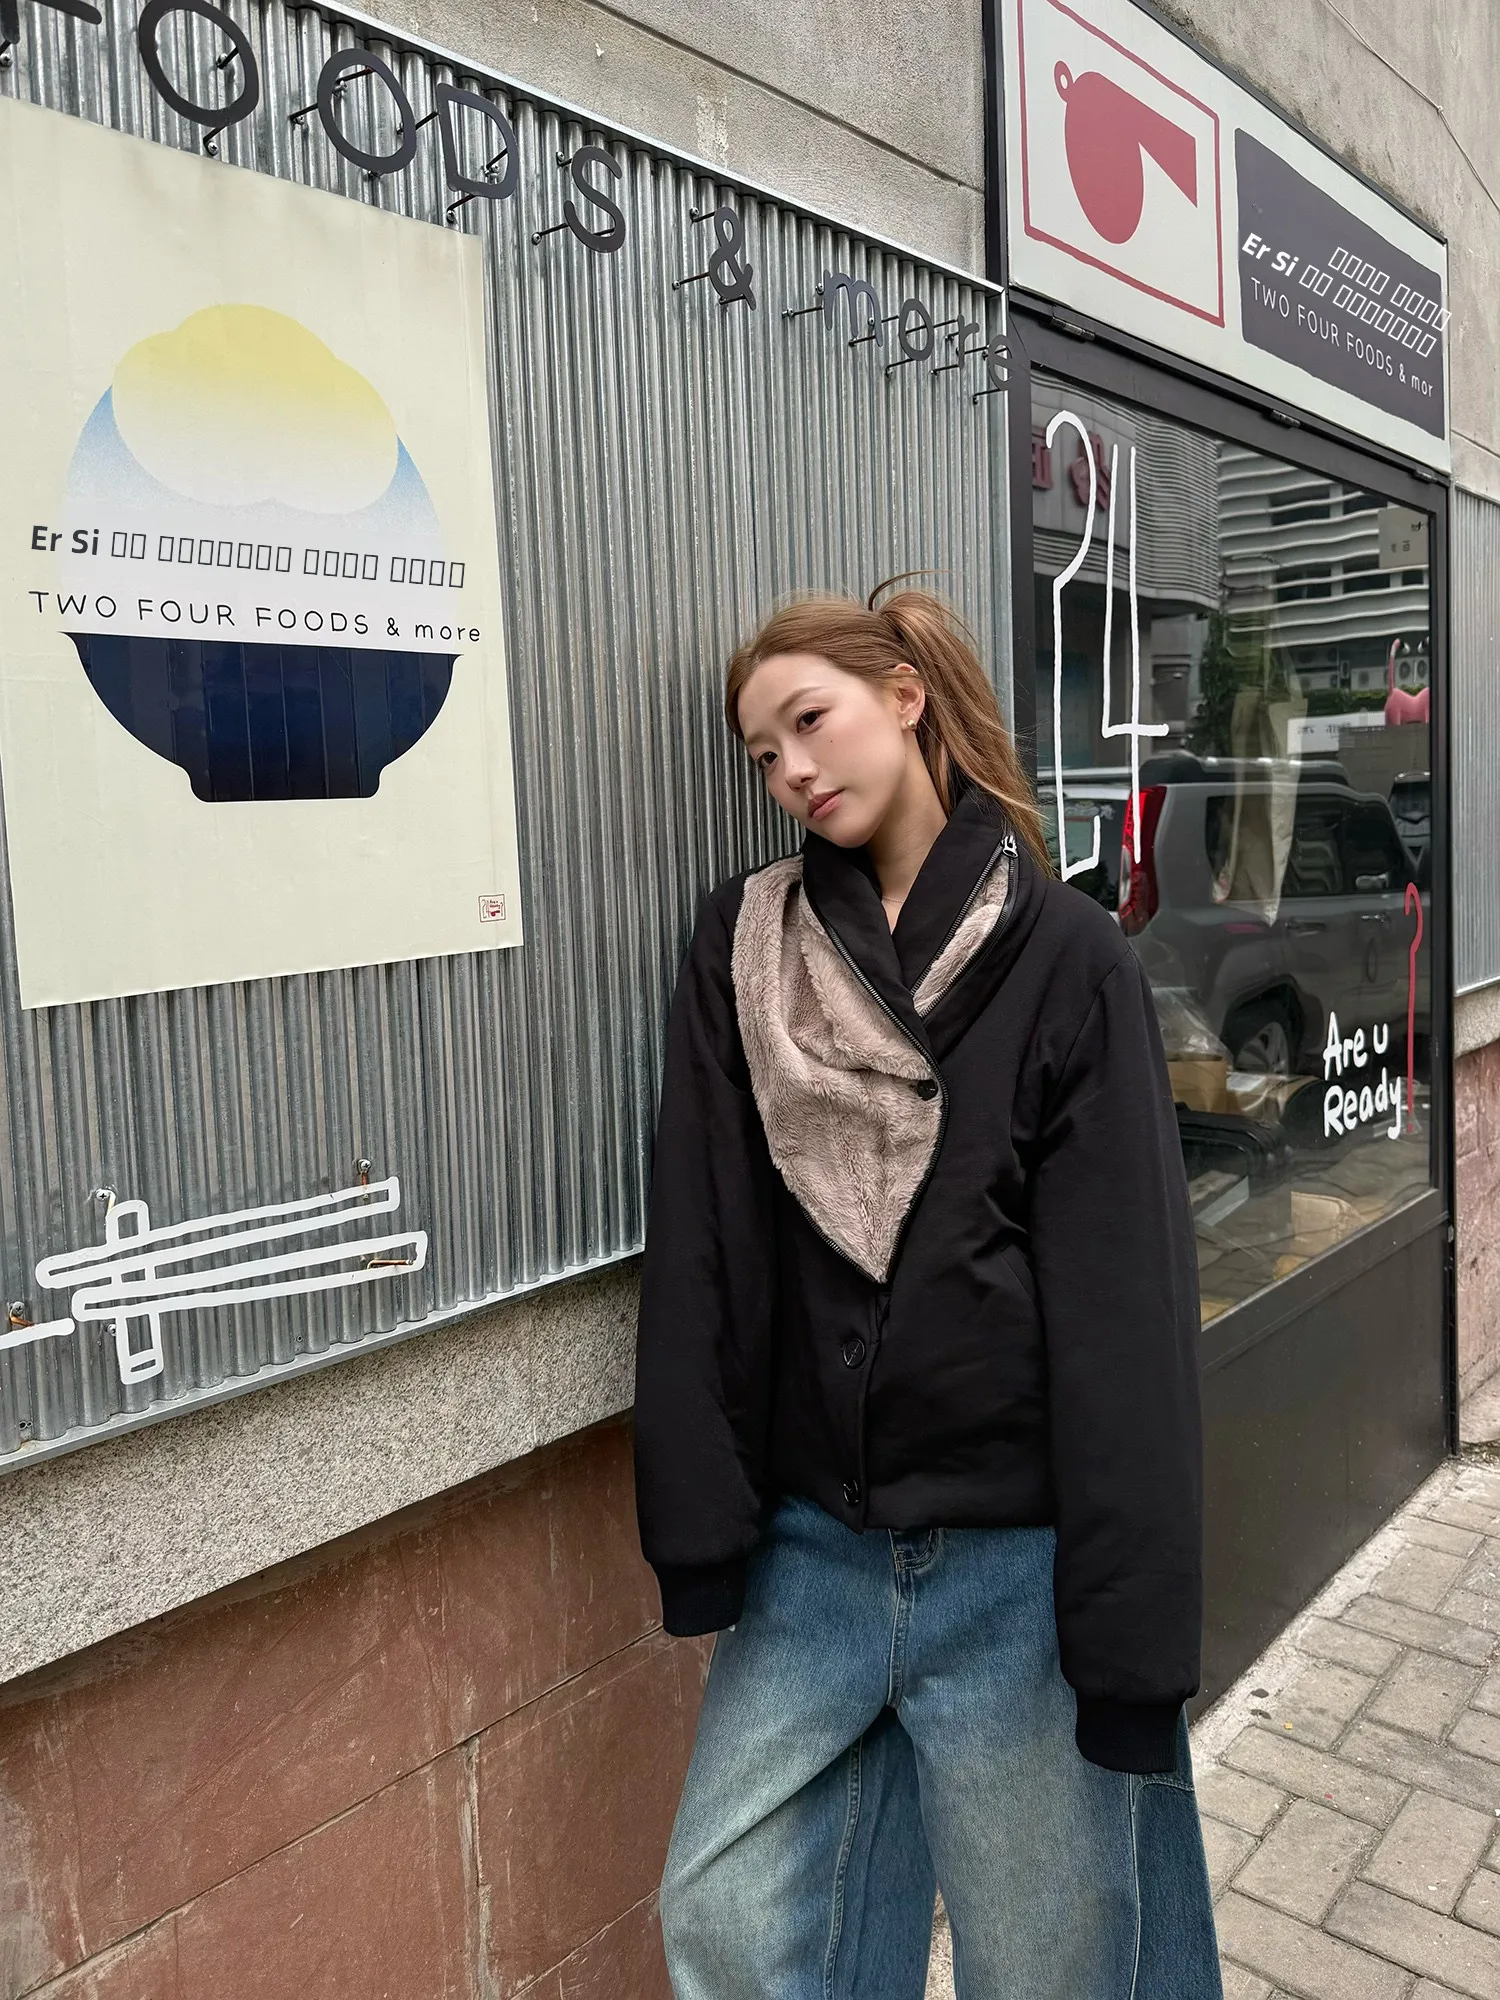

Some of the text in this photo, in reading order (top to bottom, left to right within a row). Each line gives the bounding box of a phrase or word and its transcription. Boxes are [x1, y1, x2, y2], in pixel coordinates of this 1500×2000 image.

[1241, 232, 1271, 261] Er
[1271, 251, 1300, 277] Si
[708, 206, 756, 311] &
[822, 269, 1019, 392] more
[1250, 276, 1291, 318] TWO
[1296, 303, 1340, 348] FOUR
[1346, 331, 1394, 377] FOODS
[1398, 363, 1407, 384] &
[31, 525, 100, 557] Er Si
[28, 590, 482, 643] TWO FOUR FOODS & more
[1045, 410, 1170, 882] 24
[1322, 1011, 1389, 1081] Are u
[1322, 1066, 1401, 1140] Ready
